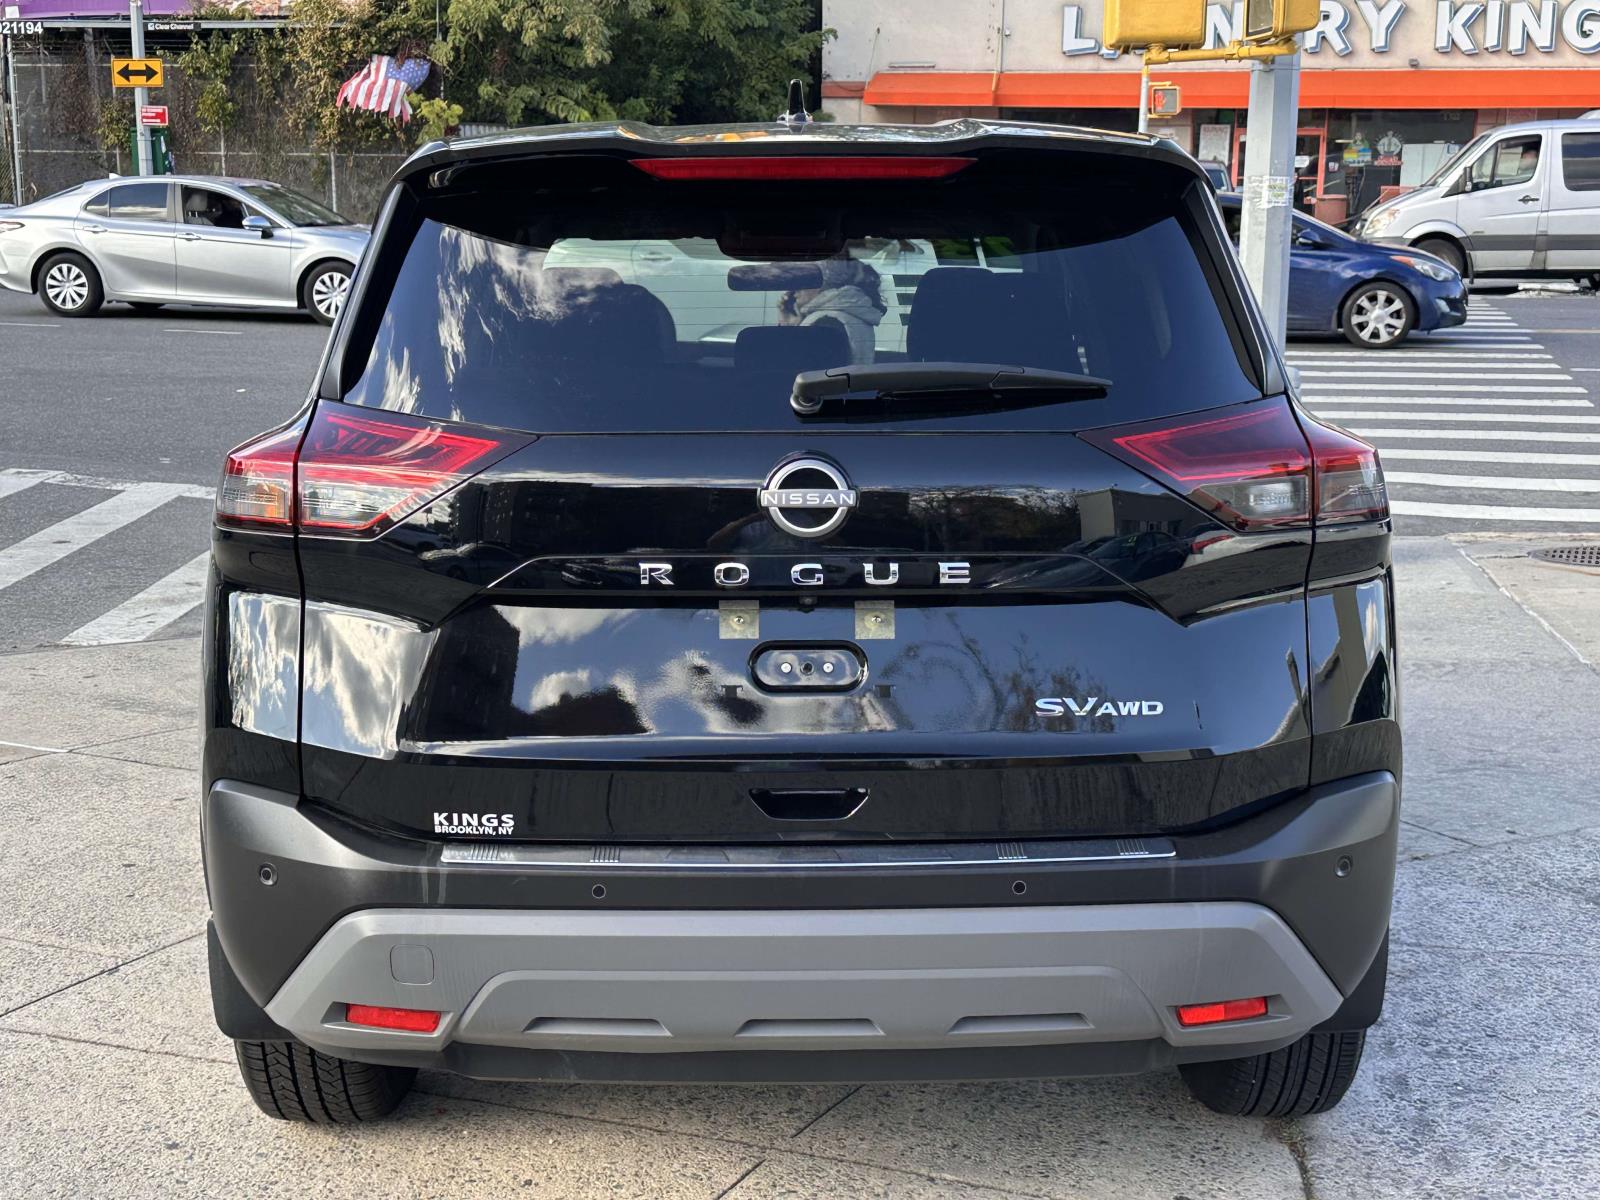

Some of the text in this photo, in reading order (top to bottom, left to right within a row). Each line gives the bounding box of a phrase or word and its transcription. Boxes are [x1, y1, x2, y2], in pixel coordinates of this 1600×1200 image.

[1063, 0, 1600, 59] LNRY KING
[764, 493, 854, 505] NISSAN
[639, 562, 971, 586] ROGUE
[433, 812, 515, 827] KINGS
[434, 825, 514, 835] BROOKLYN, NY
